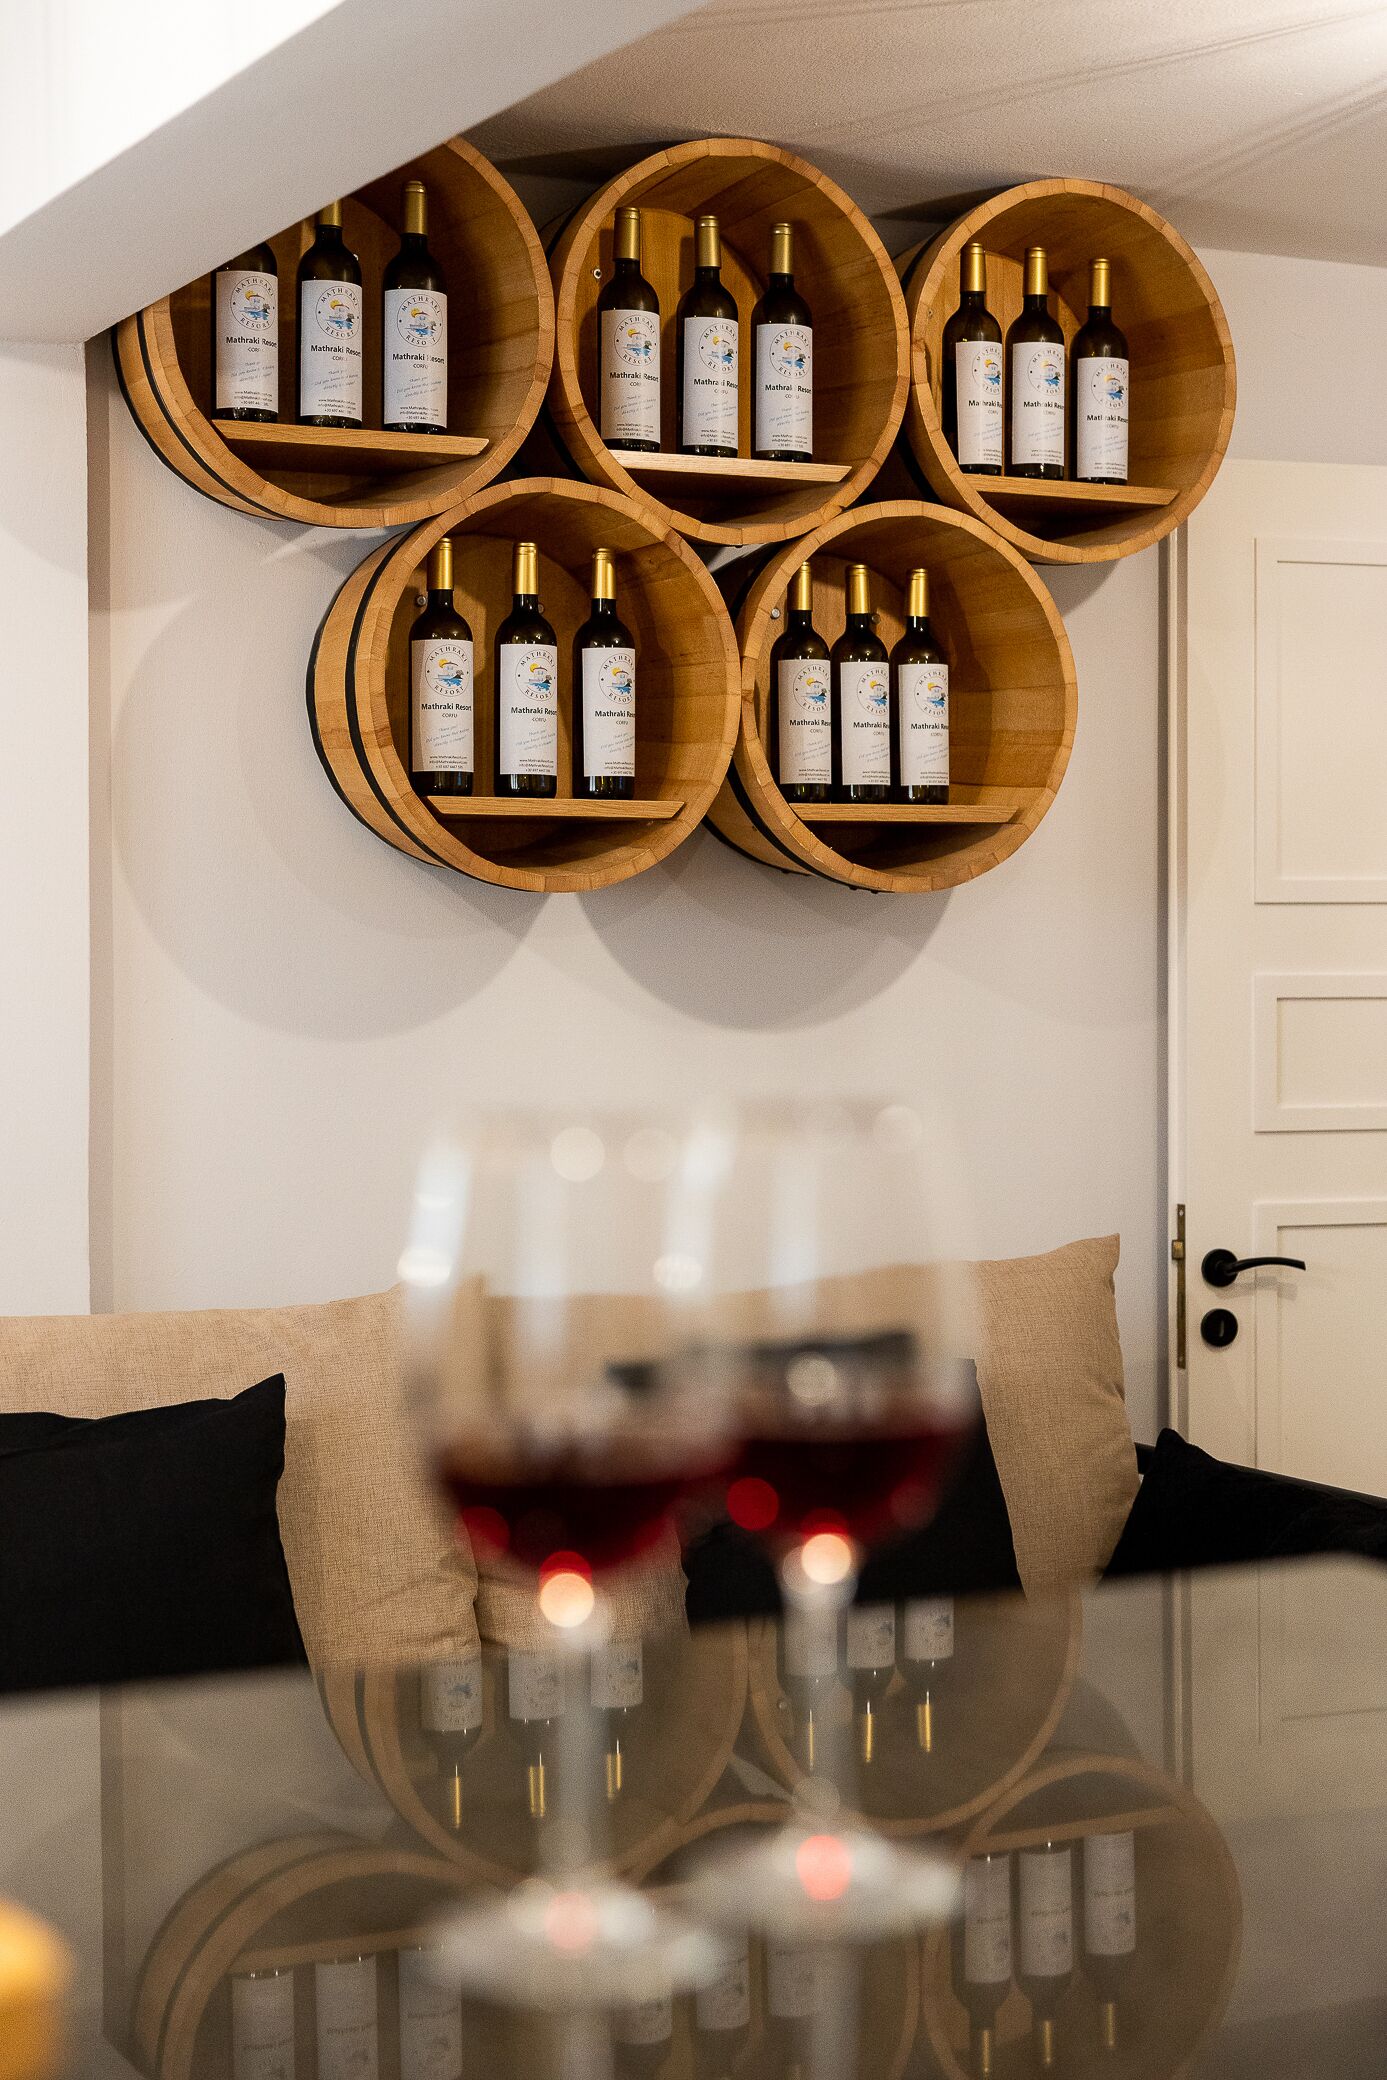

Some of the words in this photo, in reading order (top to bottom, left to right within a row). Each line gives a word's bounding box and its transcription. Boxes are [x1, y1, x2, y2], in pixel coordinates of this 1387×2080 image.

[226, 336, 259, 344] Mathraki
[430, 646, 467, 662] MATHRAKI
[521, 651, 554, 668] MATHRAKI
[434, 685, 464, 695] RESORT
[525, 689, 552, 699] RESORT
